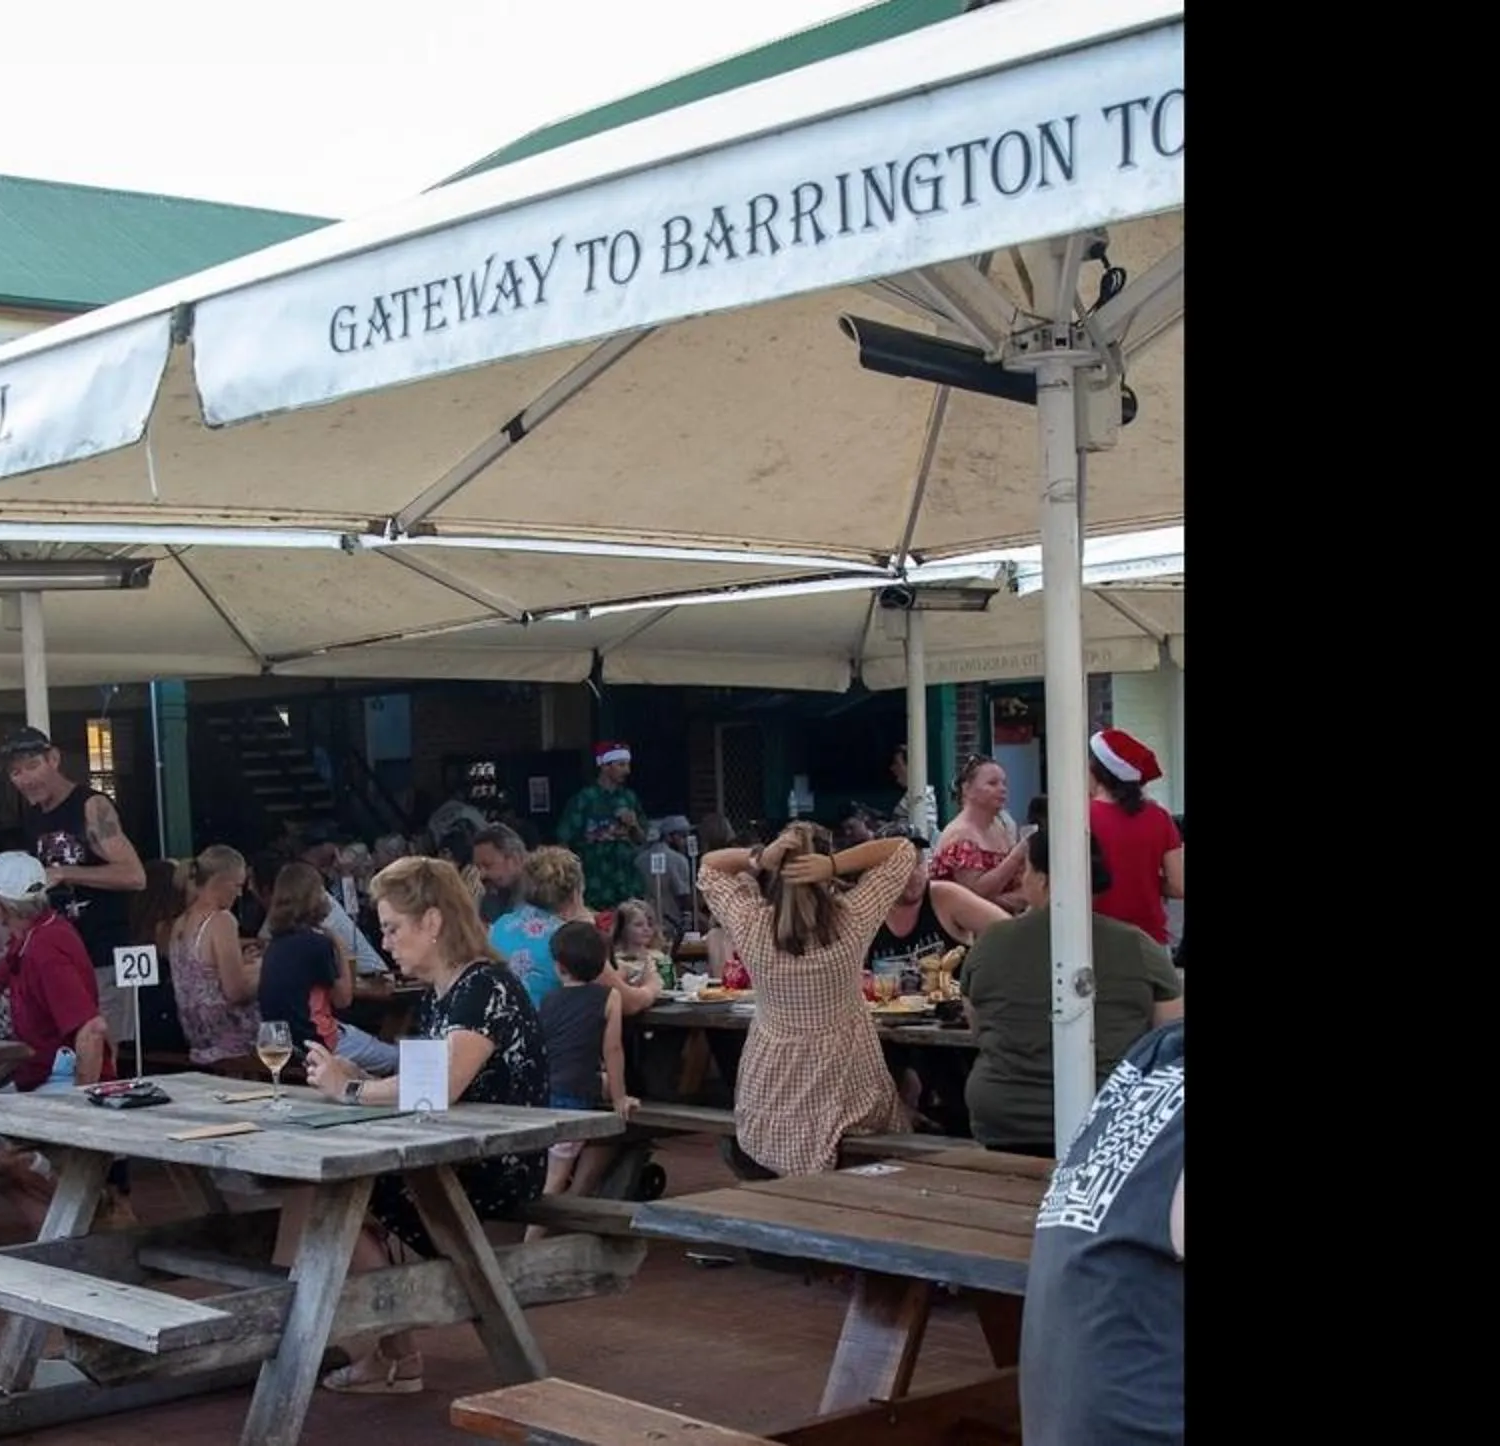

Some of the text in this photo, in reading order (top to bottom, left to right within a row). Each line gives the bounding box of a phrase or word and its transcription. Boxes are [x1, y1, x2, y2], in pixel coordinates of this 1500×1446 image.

[329, 234, 566, 353] GATEWAY
[575, 229, 642, 293] TO
[660, 114, 1080, 274] BARRINGTON
[122, 953, 151, 979] 20
